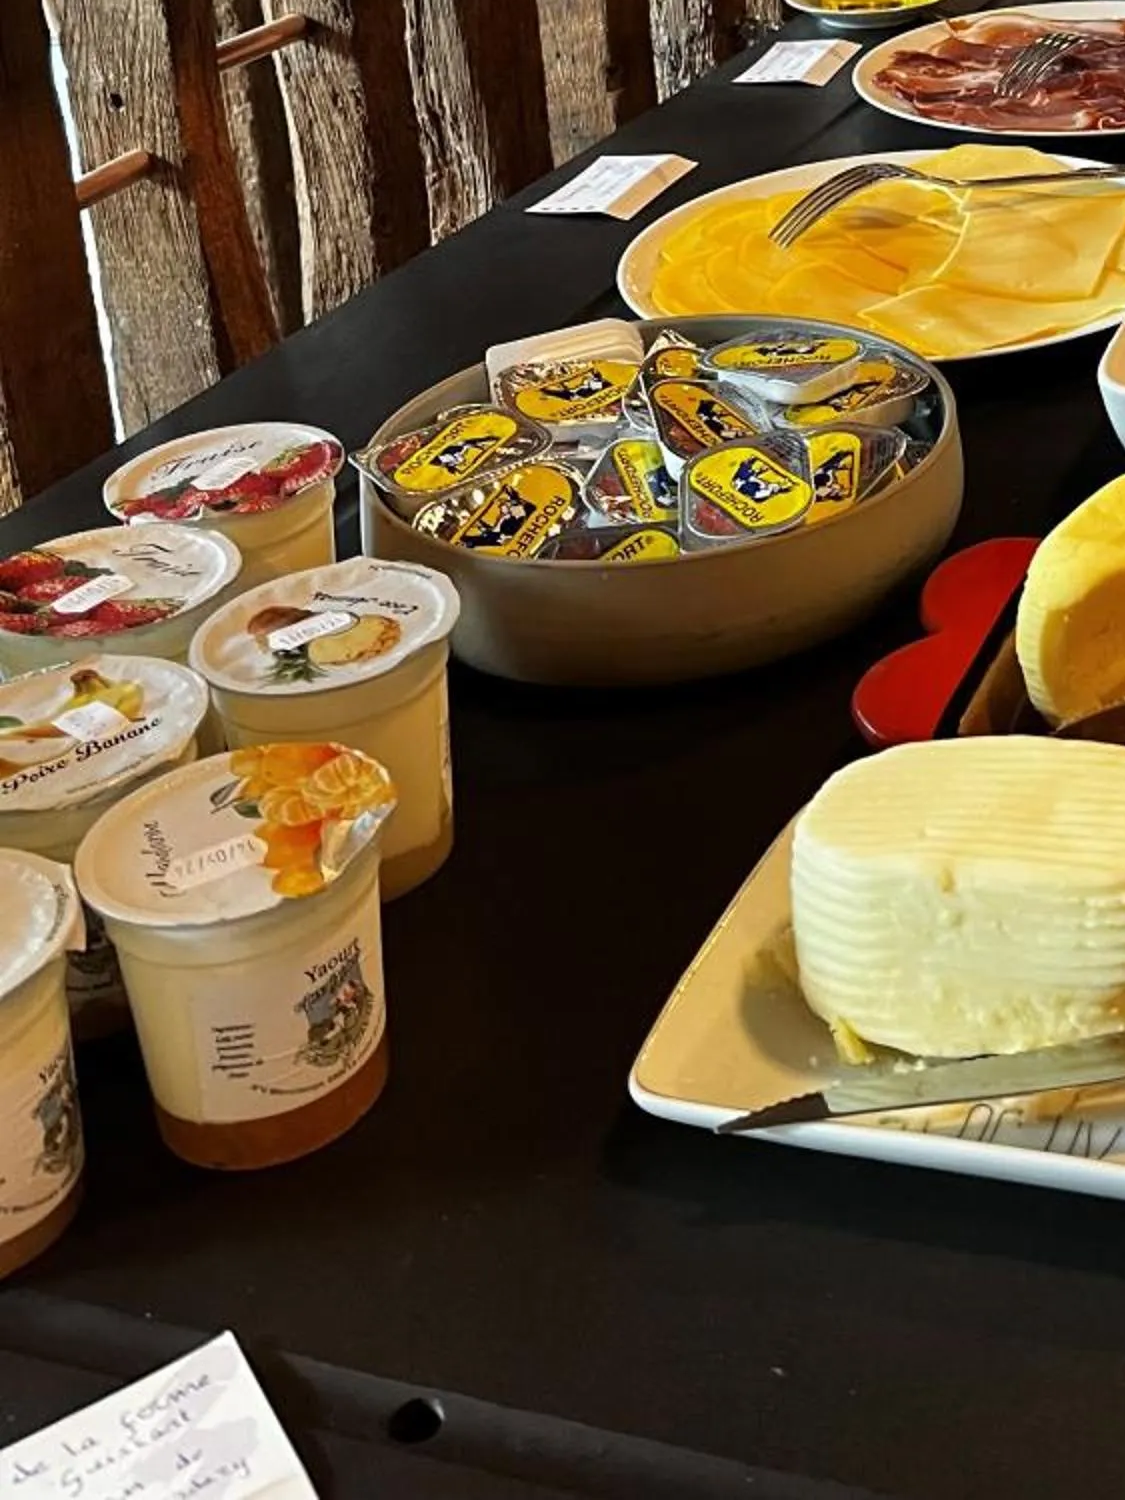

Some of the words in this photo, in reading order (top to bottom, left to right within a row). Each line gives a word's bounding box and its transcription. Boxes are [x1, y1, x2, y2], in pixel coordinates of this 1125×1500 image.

[695, 471, 765, 524] ROCHEFORT
[2, 757, 70, 795] Poire
[75, 716, 163, 763] Banane
[304, 936, 361, 985] Yaourt
[61, 1436, 97, 1457] la
